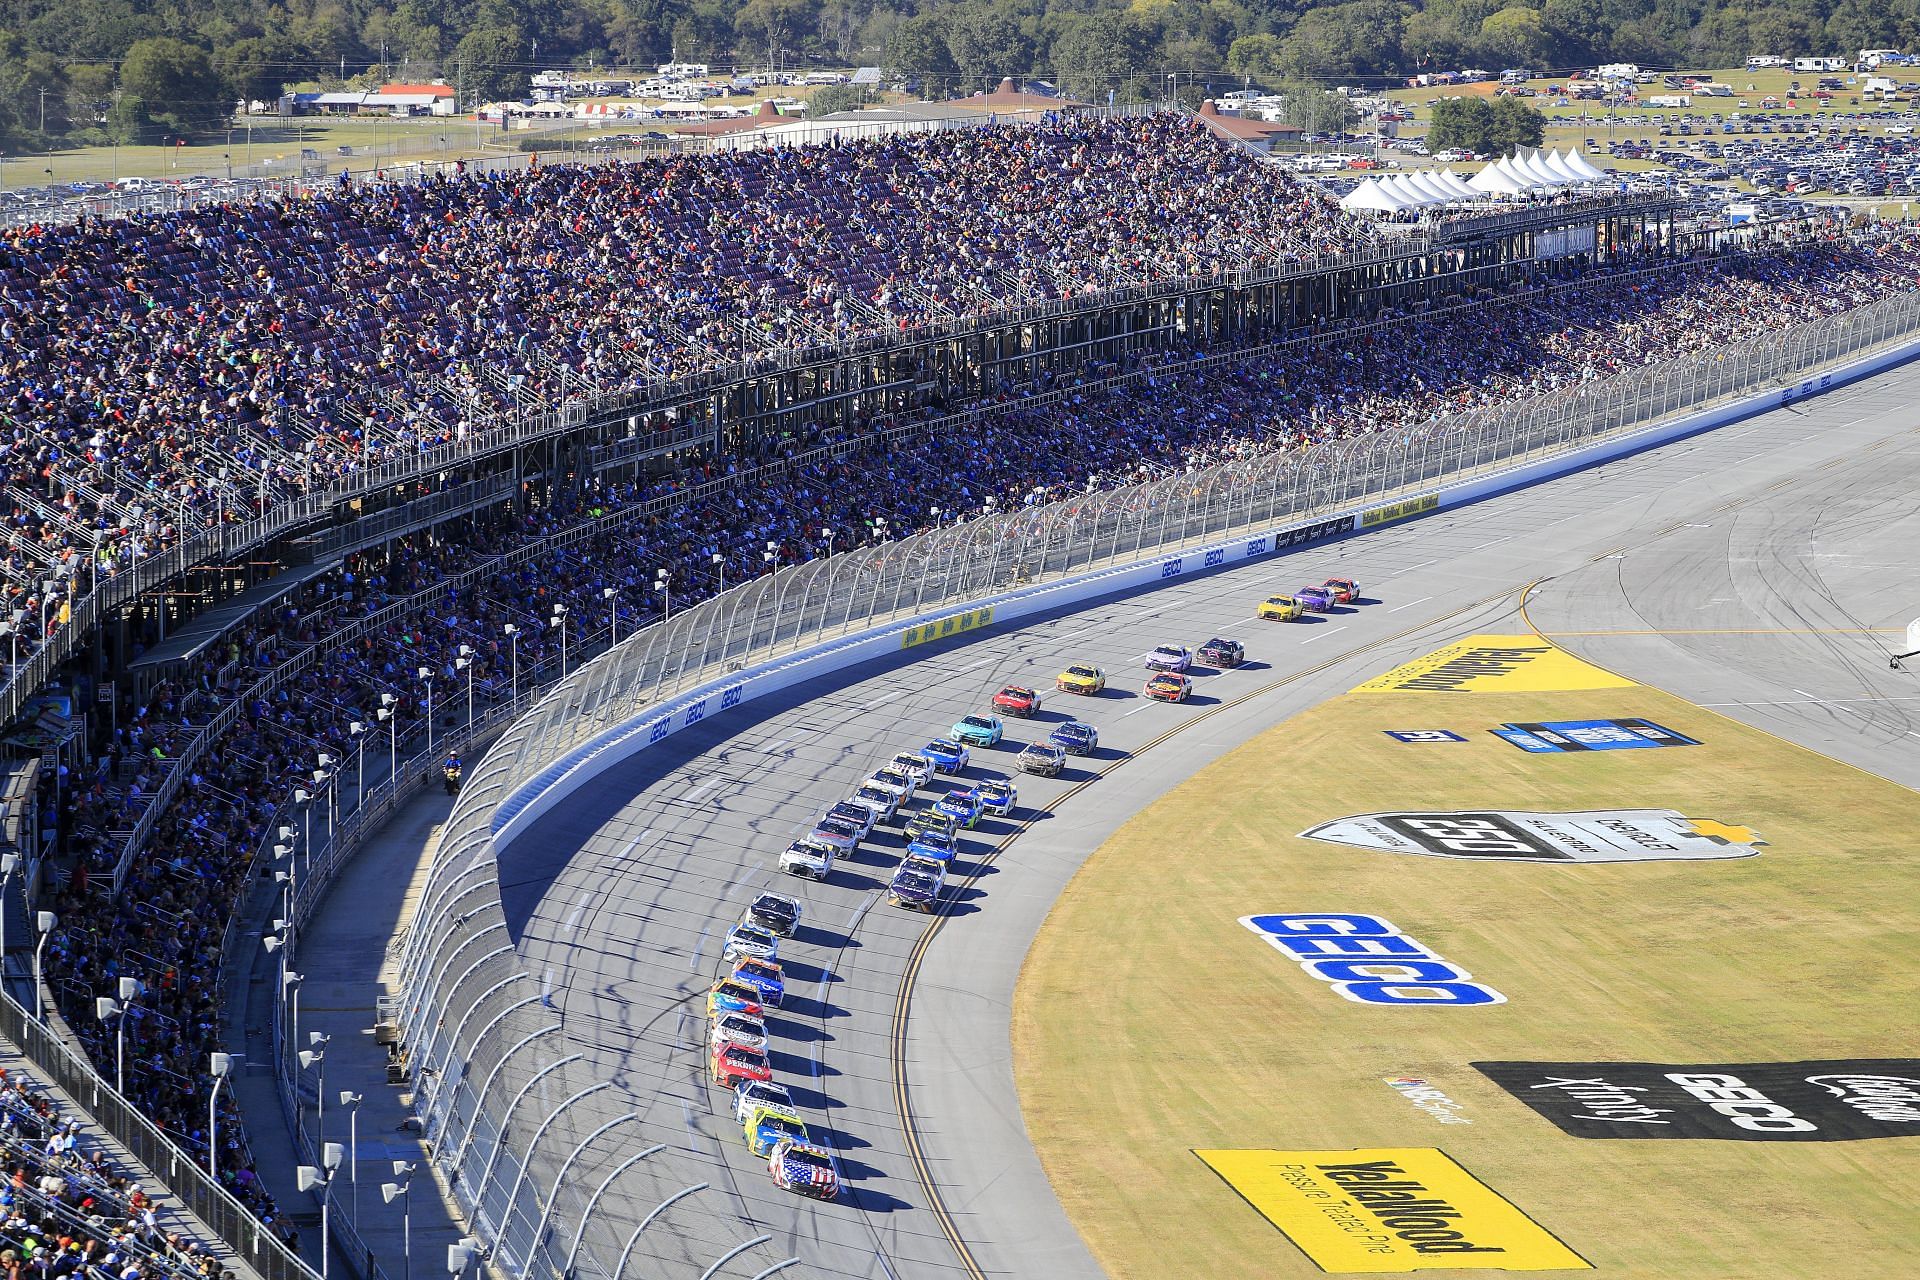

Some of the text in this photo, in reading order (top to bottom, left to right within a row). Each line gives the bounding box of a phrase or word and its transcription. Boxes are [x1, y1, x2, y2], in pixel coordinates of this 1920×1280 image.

[1204, 548, 1224, 567] GEICO
[1246, 538, 1266, 556] GEICO
[1161, 558, 1182, 578] GEICO
[1392, 646, 1553, 692] YellaWood
[685, 700, 706, 726] GEICO
[720, 685, 743, 710] GEICO
[649, 717, 671, 743] GEICO
[1398, 818, 1538, 854] 250
[1524, 819, 1600, 854] SILVERADO
[1594, 819, 1680, 852] CHEVROLET
[1248, 912, 1500, 1007] GEICO
[1663, 1073, 1819, 1133] GEICO
[1269, 1163, 1396, 1255] Pressure Treated Pine
[1314, 1160, 1506, 1254] YellaWood
